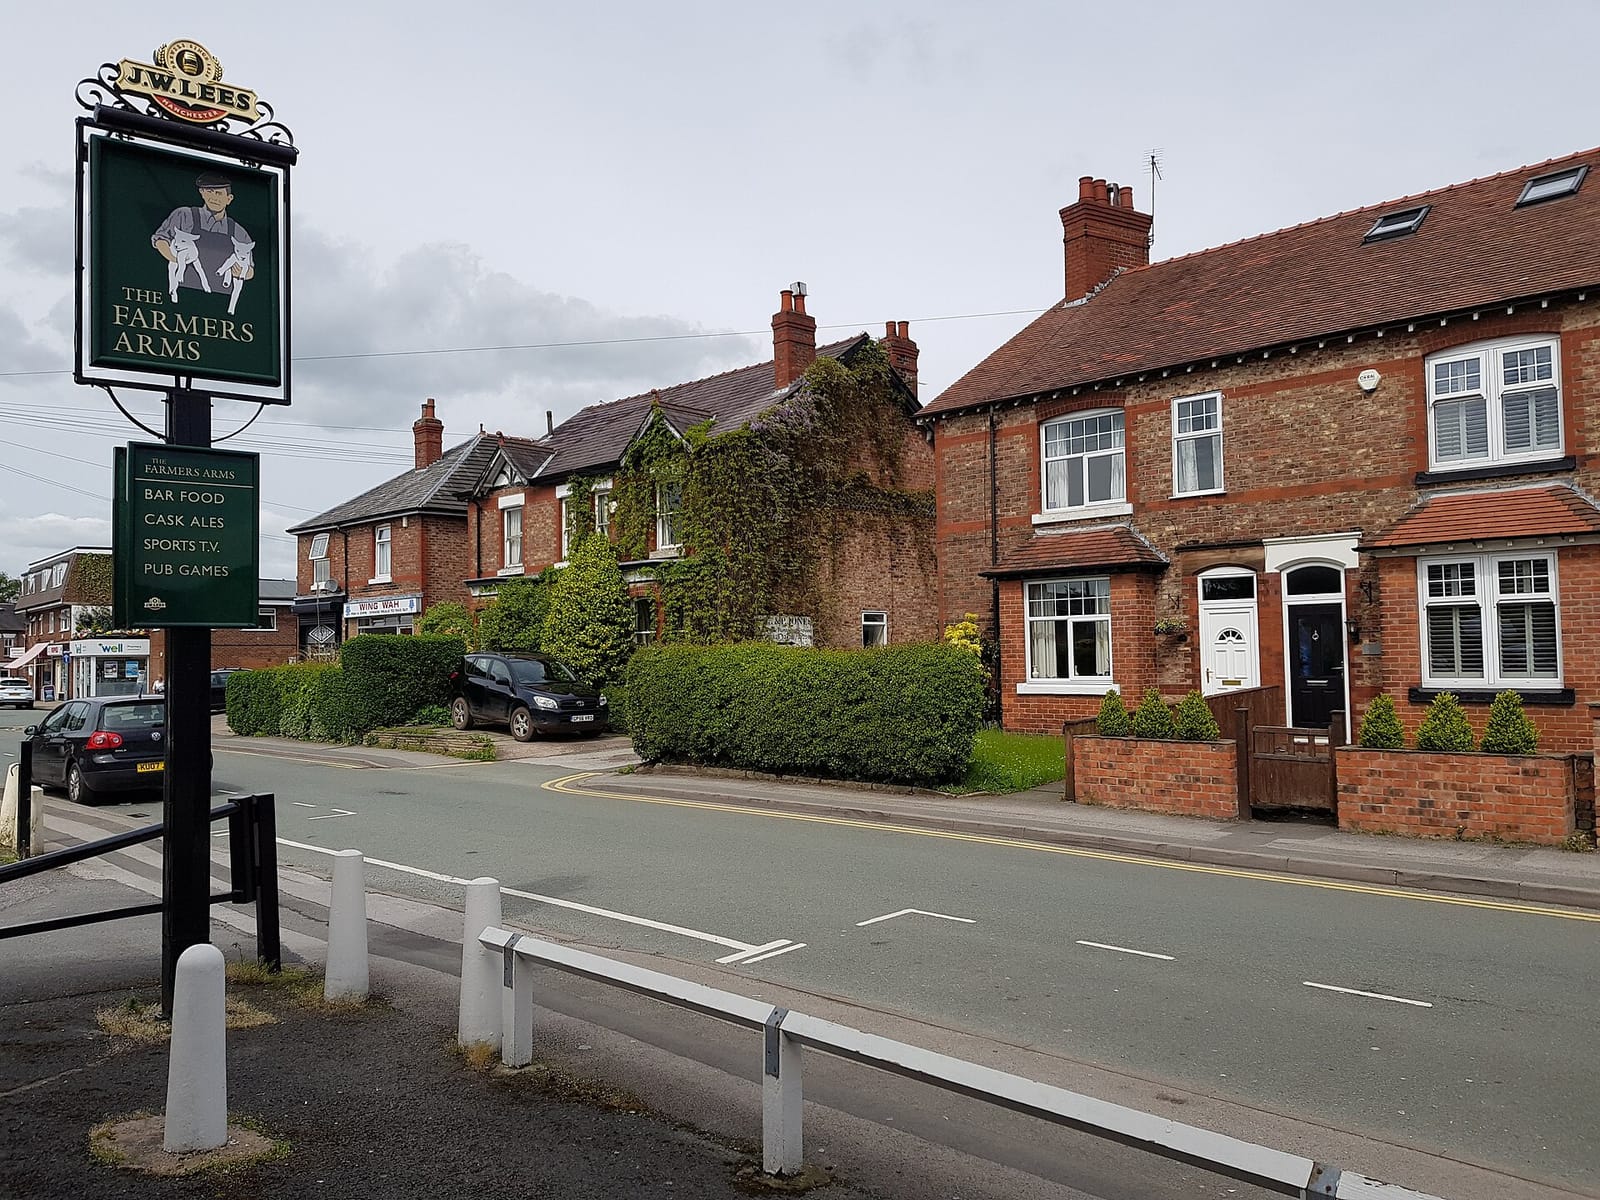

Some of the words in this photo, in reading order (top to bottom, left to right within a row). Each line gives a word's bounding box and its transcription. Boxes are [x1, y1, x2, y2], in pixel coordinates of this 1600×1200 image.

[162, 99, 219, 118] MANCHESTER
[122, 287, 163, 305] THE
[112, 304, 255, 343] FARMERS
[113, 331, 200, 361] ARMS
[145, 464, 200, 477] FARMERS
[202, 468, 235, 480] ARMS
[144, 488, 174, 501] BAR
[180, 491, 225, 504] FOOD
[144, 513, 185, 527] CASK
[190, 516, 224, 529] ALES
[143, 538, 196, 552] SPORTS
[199, 541, 220, 553] T.V.
[144, 563, 173, 575] PUB
[179, 564, 229, 577] GAMES
[359, 602, 378, 611] WING
[382, 601, 400, 609] WAH
[101, 643, 123, 652] well
